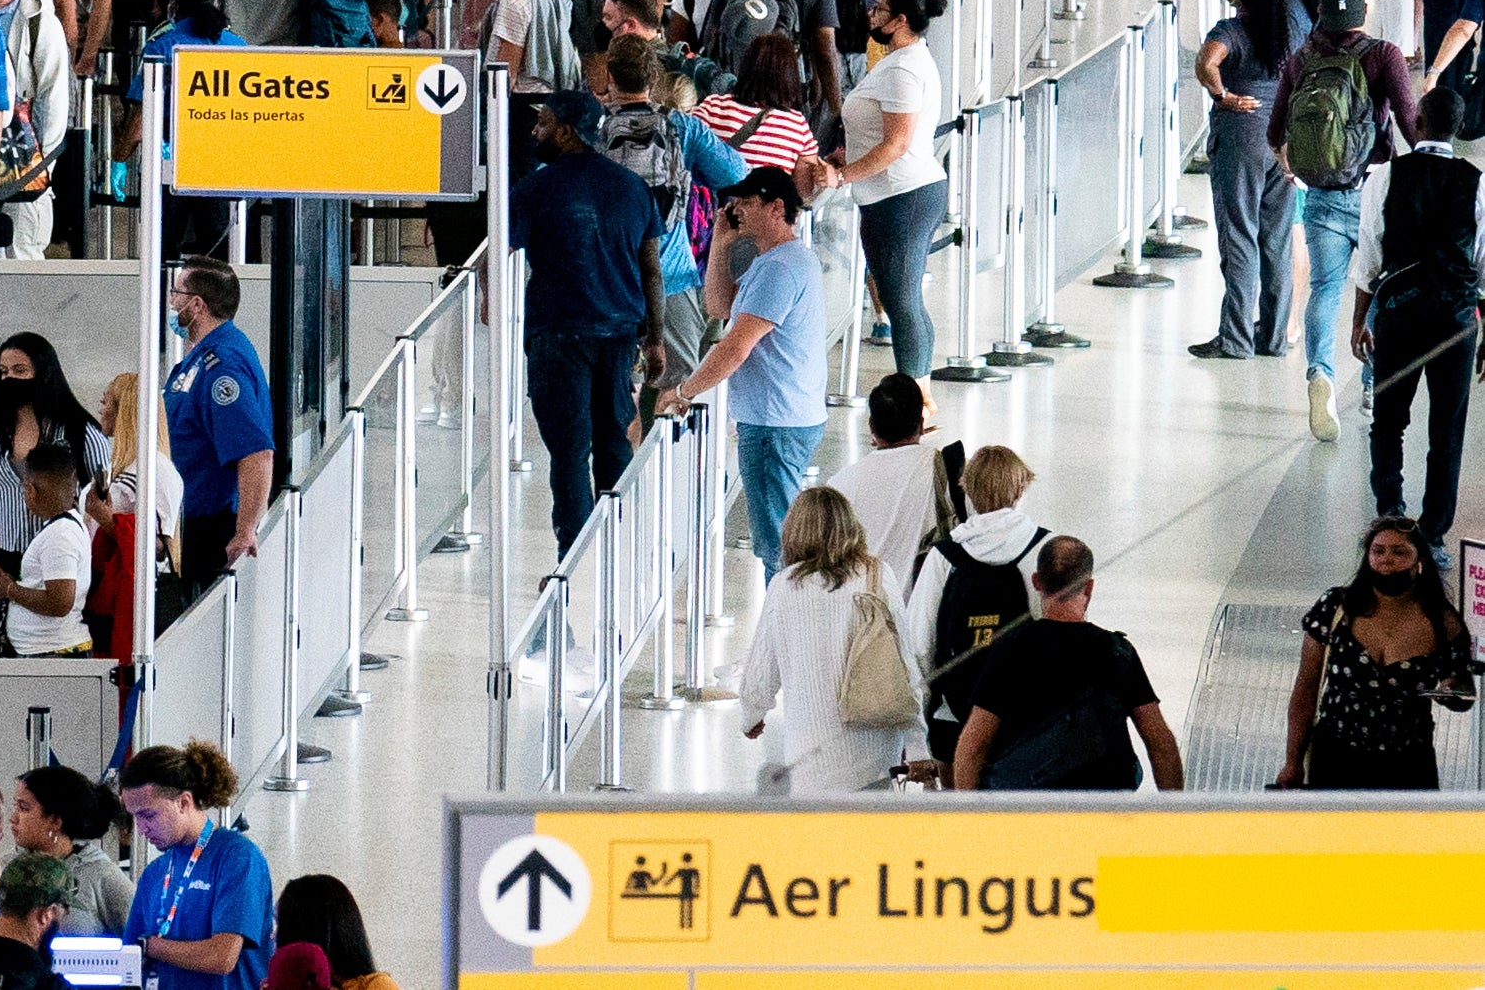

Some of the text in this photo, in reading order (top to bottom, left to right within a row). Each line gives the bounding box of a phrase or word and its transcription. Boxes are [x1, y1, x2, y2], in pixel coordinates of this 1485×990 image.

[187, 70, 331, 100] All Gates
[187, 108, 305, 124] Todas las puertas
[729, 858, 1097, 934] Aer Lingus
